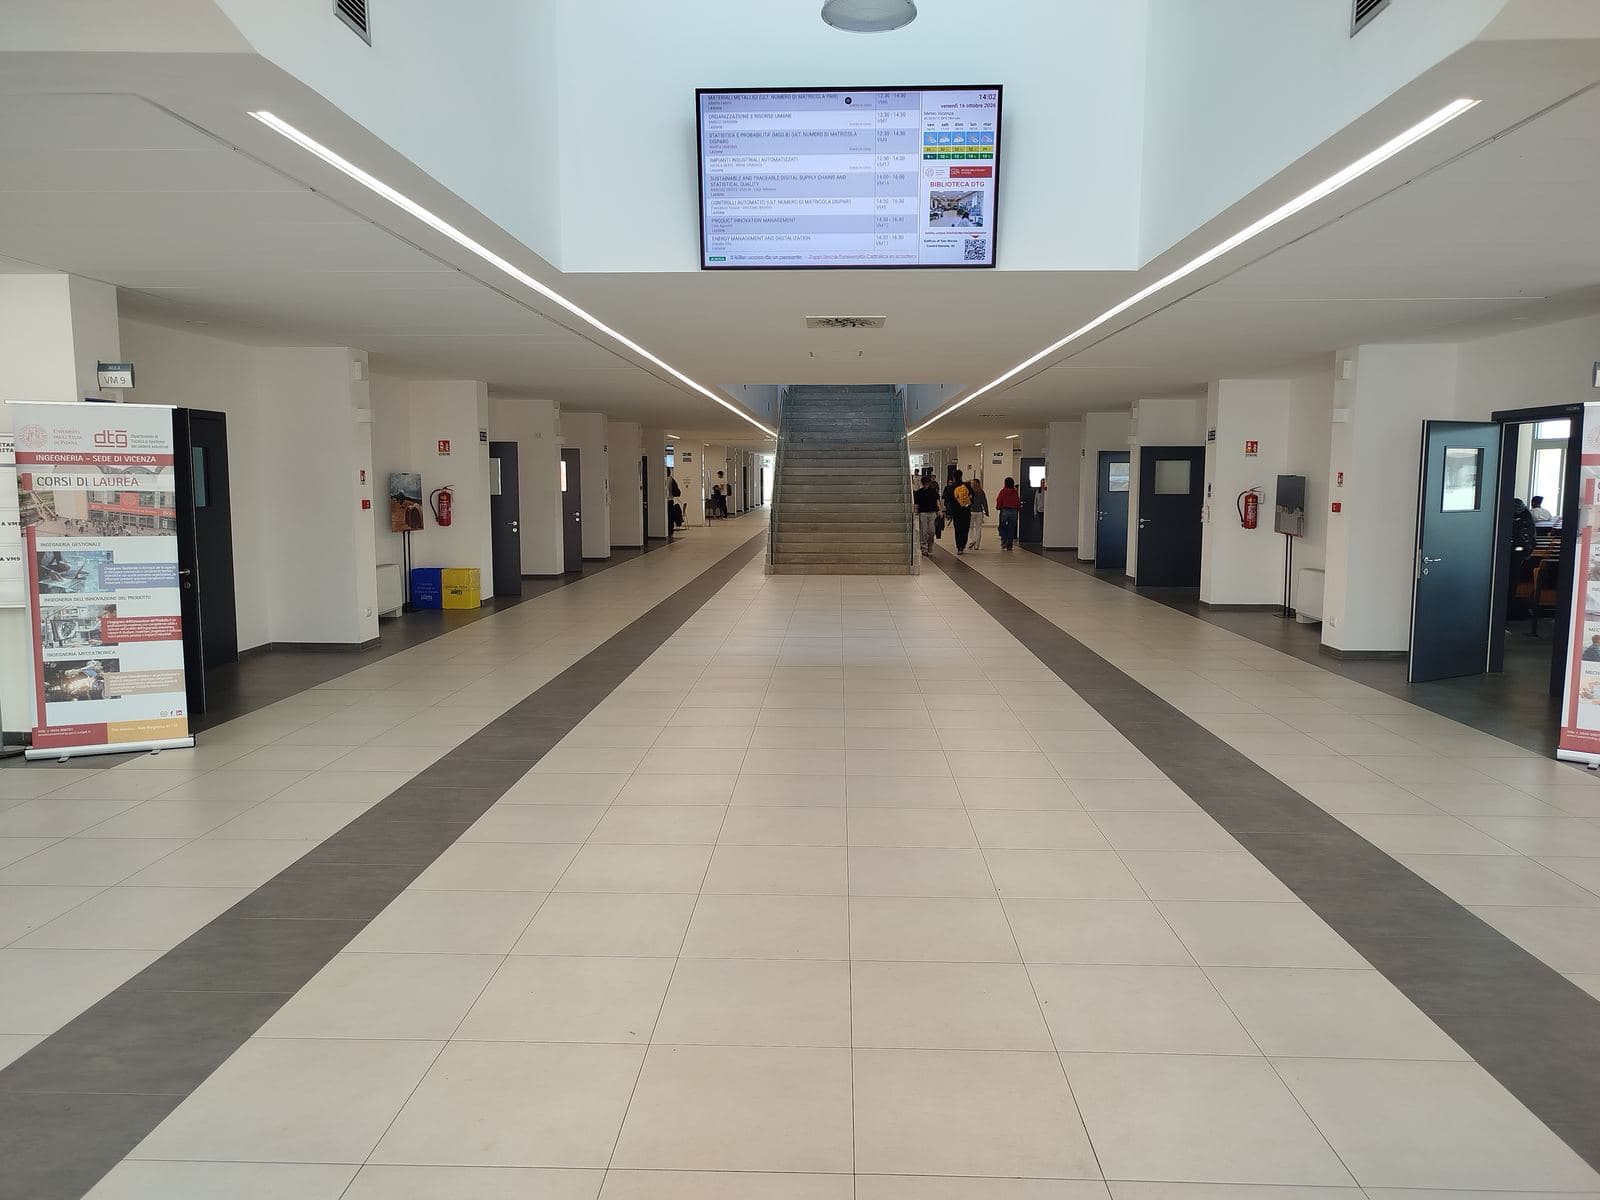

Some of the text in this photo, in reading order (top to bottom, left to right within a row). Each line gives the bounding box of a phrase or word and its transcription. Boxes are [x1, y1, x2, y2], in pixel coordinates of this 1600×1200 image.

[37, 476, 139, 487] CORSI DI LAUREA
